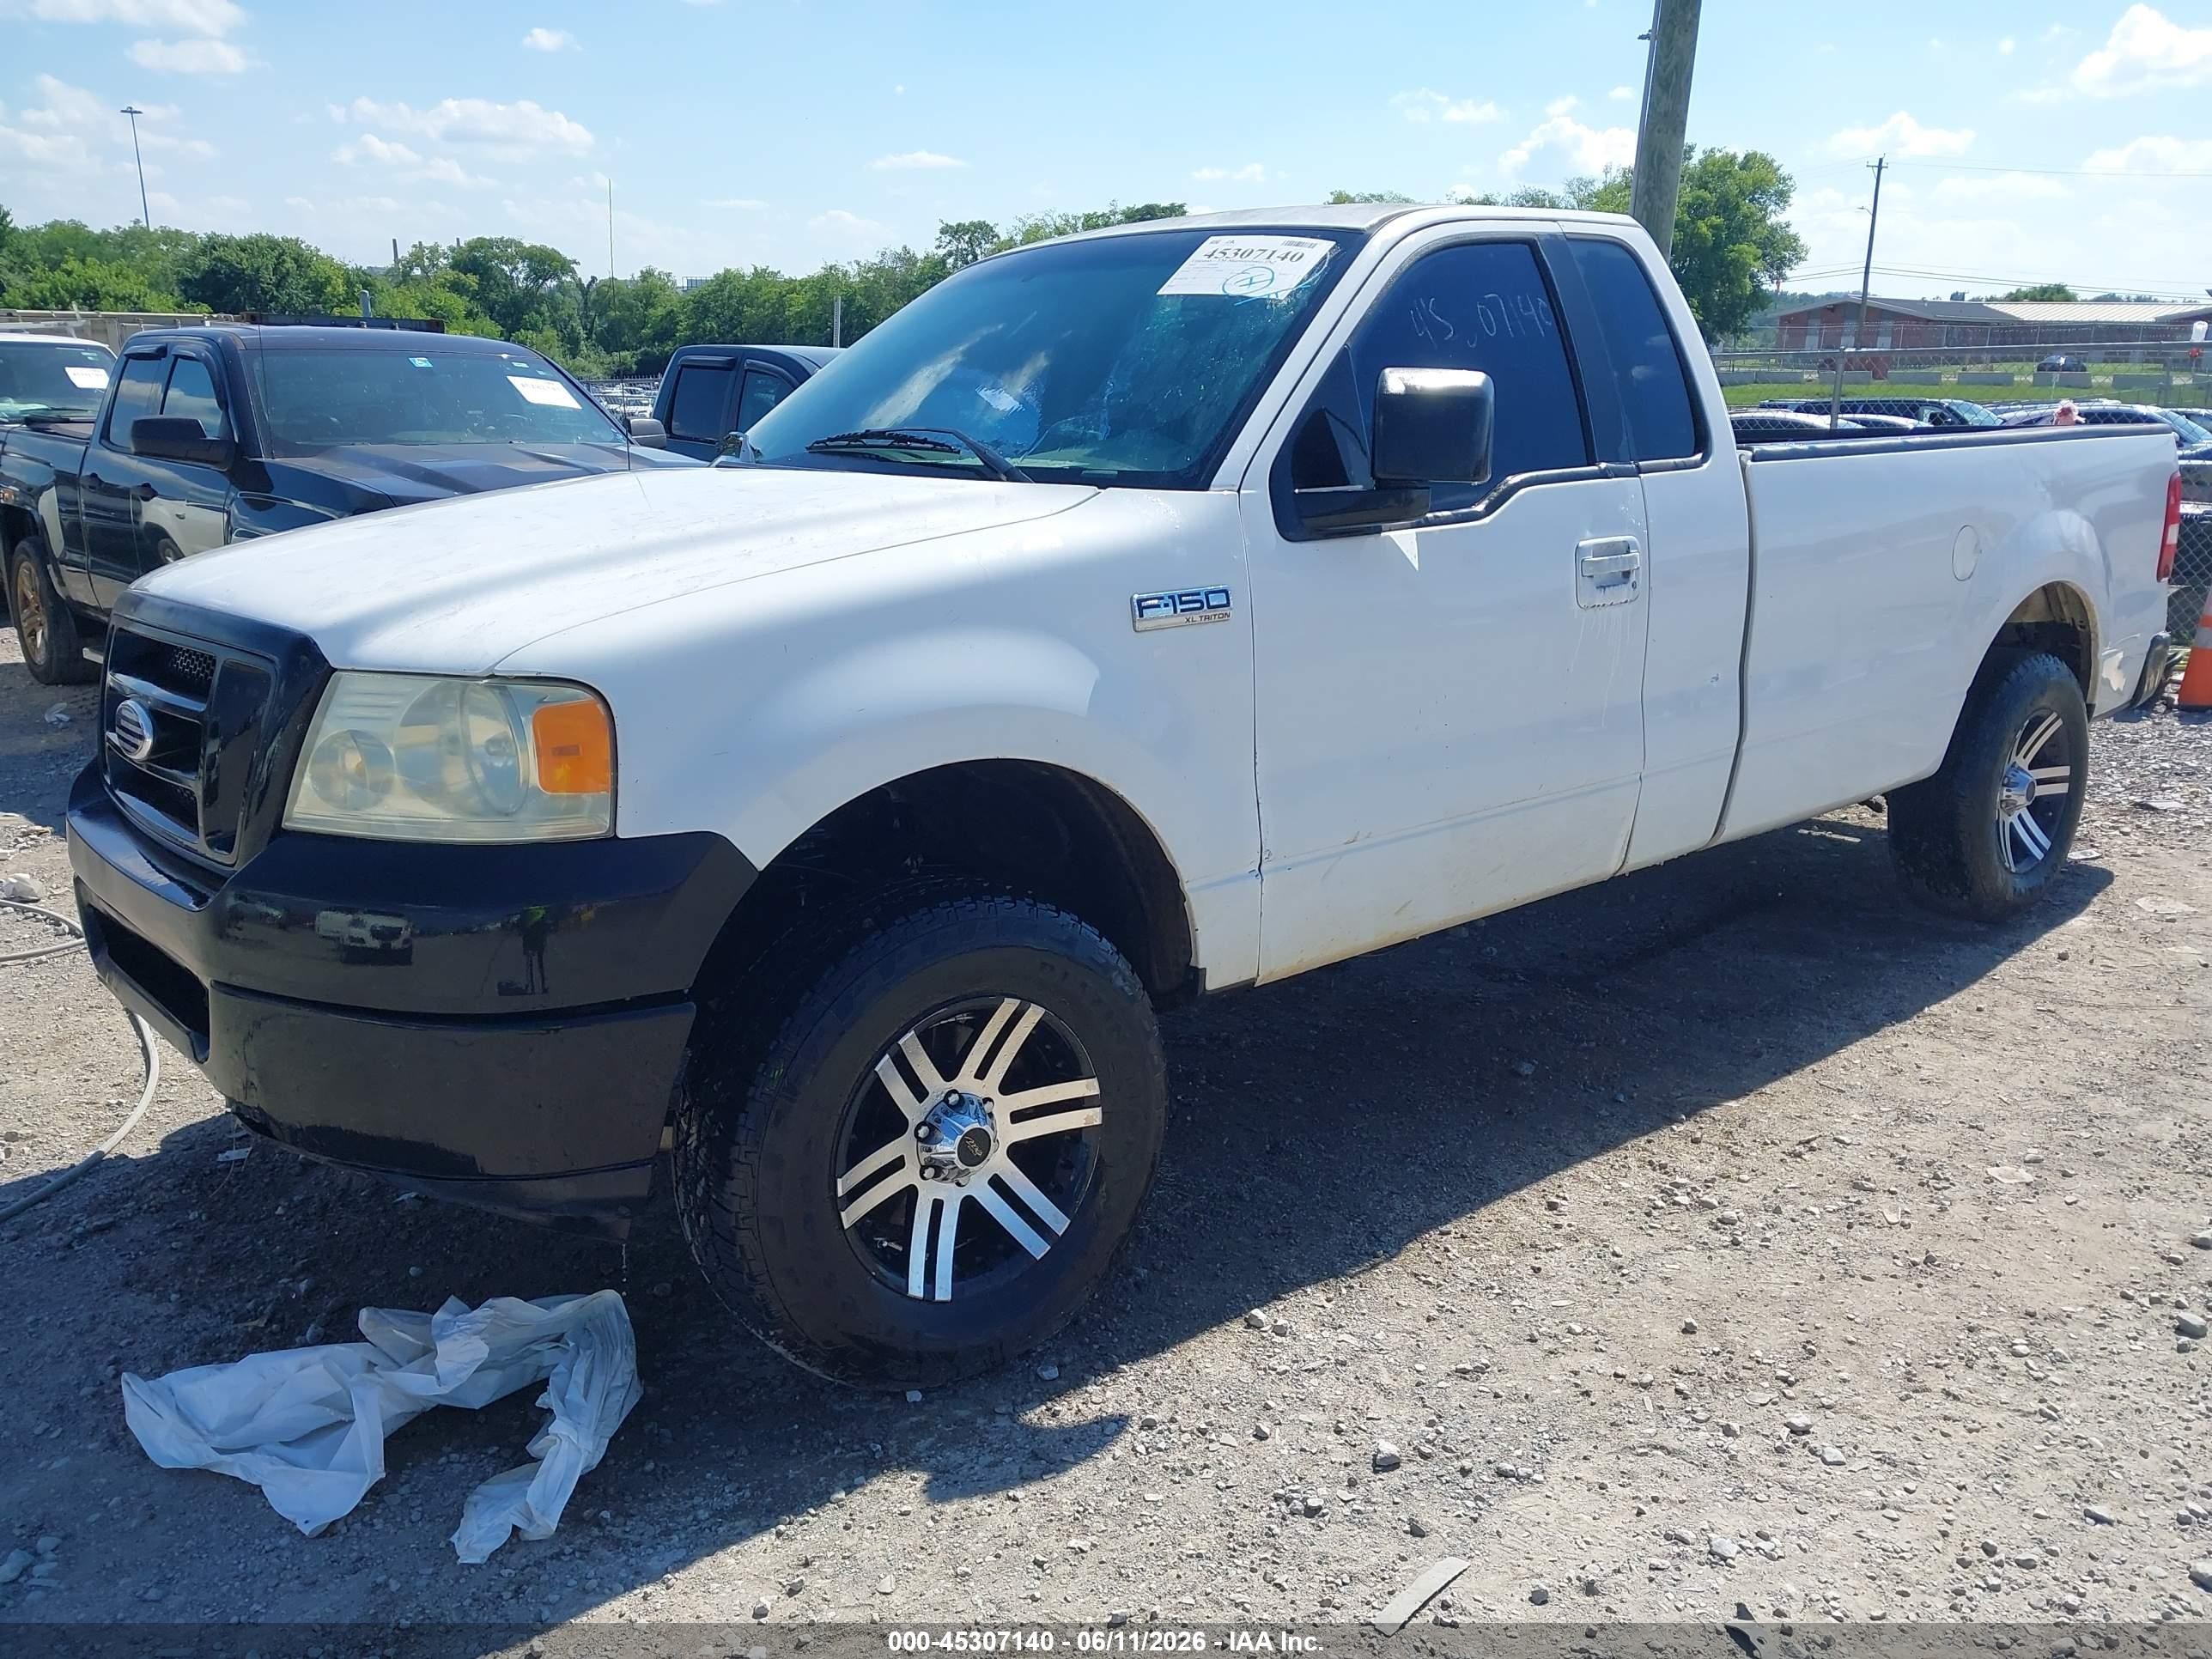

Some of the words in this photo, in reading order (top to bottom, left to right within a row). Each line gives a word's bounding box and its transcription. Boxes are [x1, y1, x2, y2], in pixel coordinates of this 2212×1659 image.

[1202, 246, 1305, 264] 45307140
[1136, 588, 1231, 617] F-150
[1184, 616, 1198, 624] XL
[1200, 611, 1231, 623] TRITON
